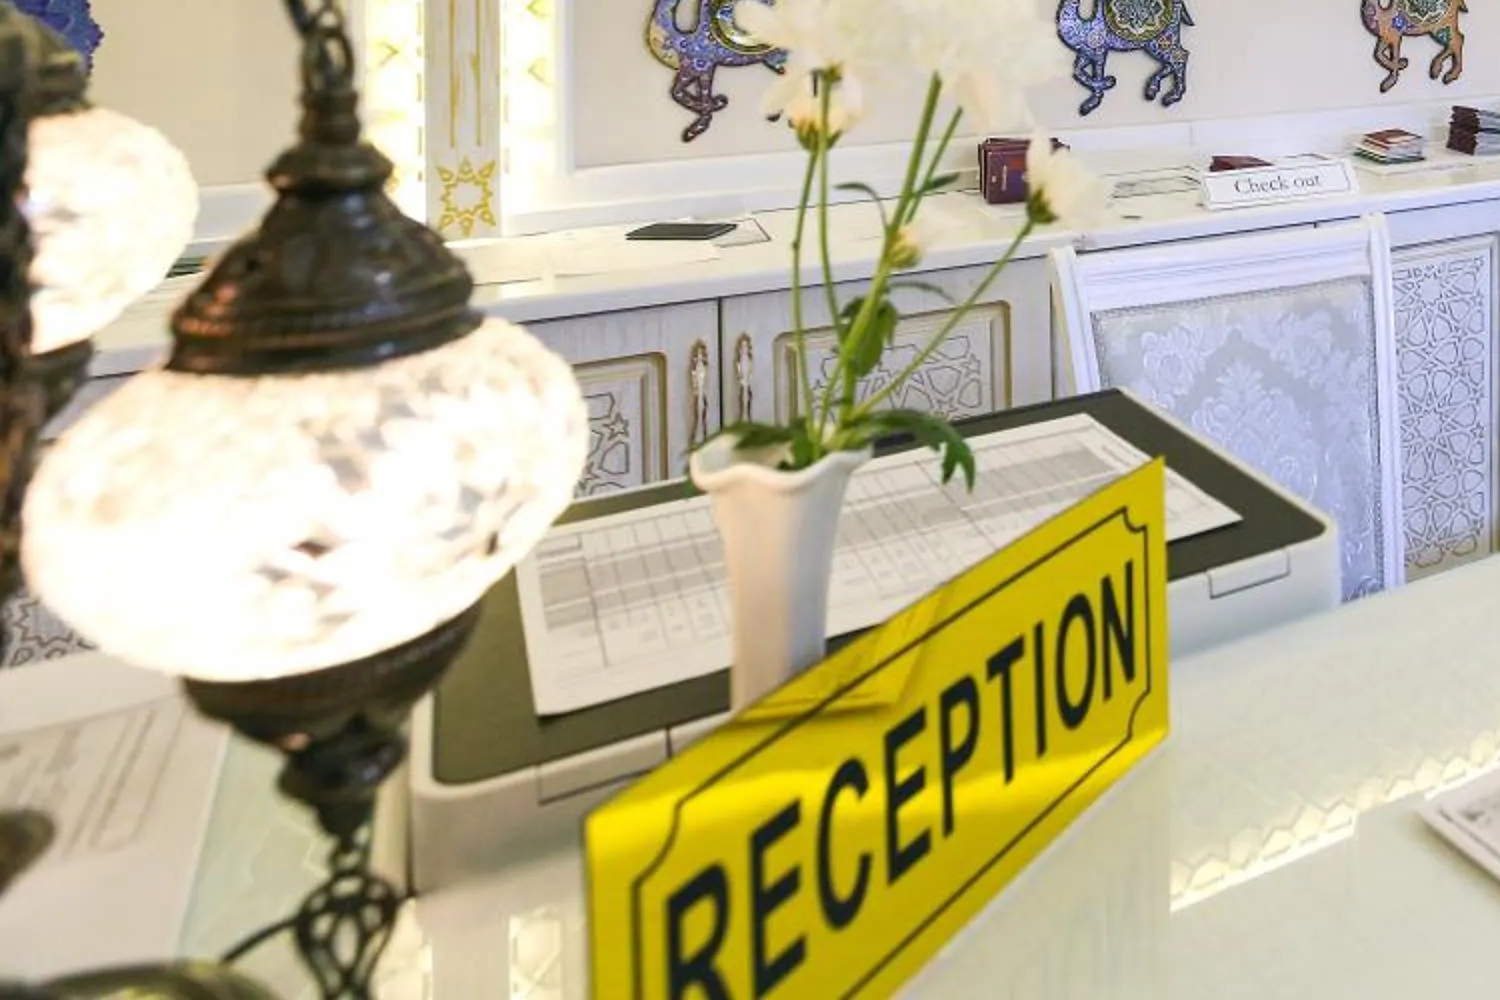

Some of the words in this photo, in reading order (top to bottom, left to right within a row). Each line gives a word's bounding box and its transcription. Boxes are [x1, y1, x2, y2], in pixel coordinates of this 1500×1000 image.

[1234, 176, 1289, 193] Check
[1294, 175, 1321, 187] out
[664, 558, 1138, 1000] RECEPTION
